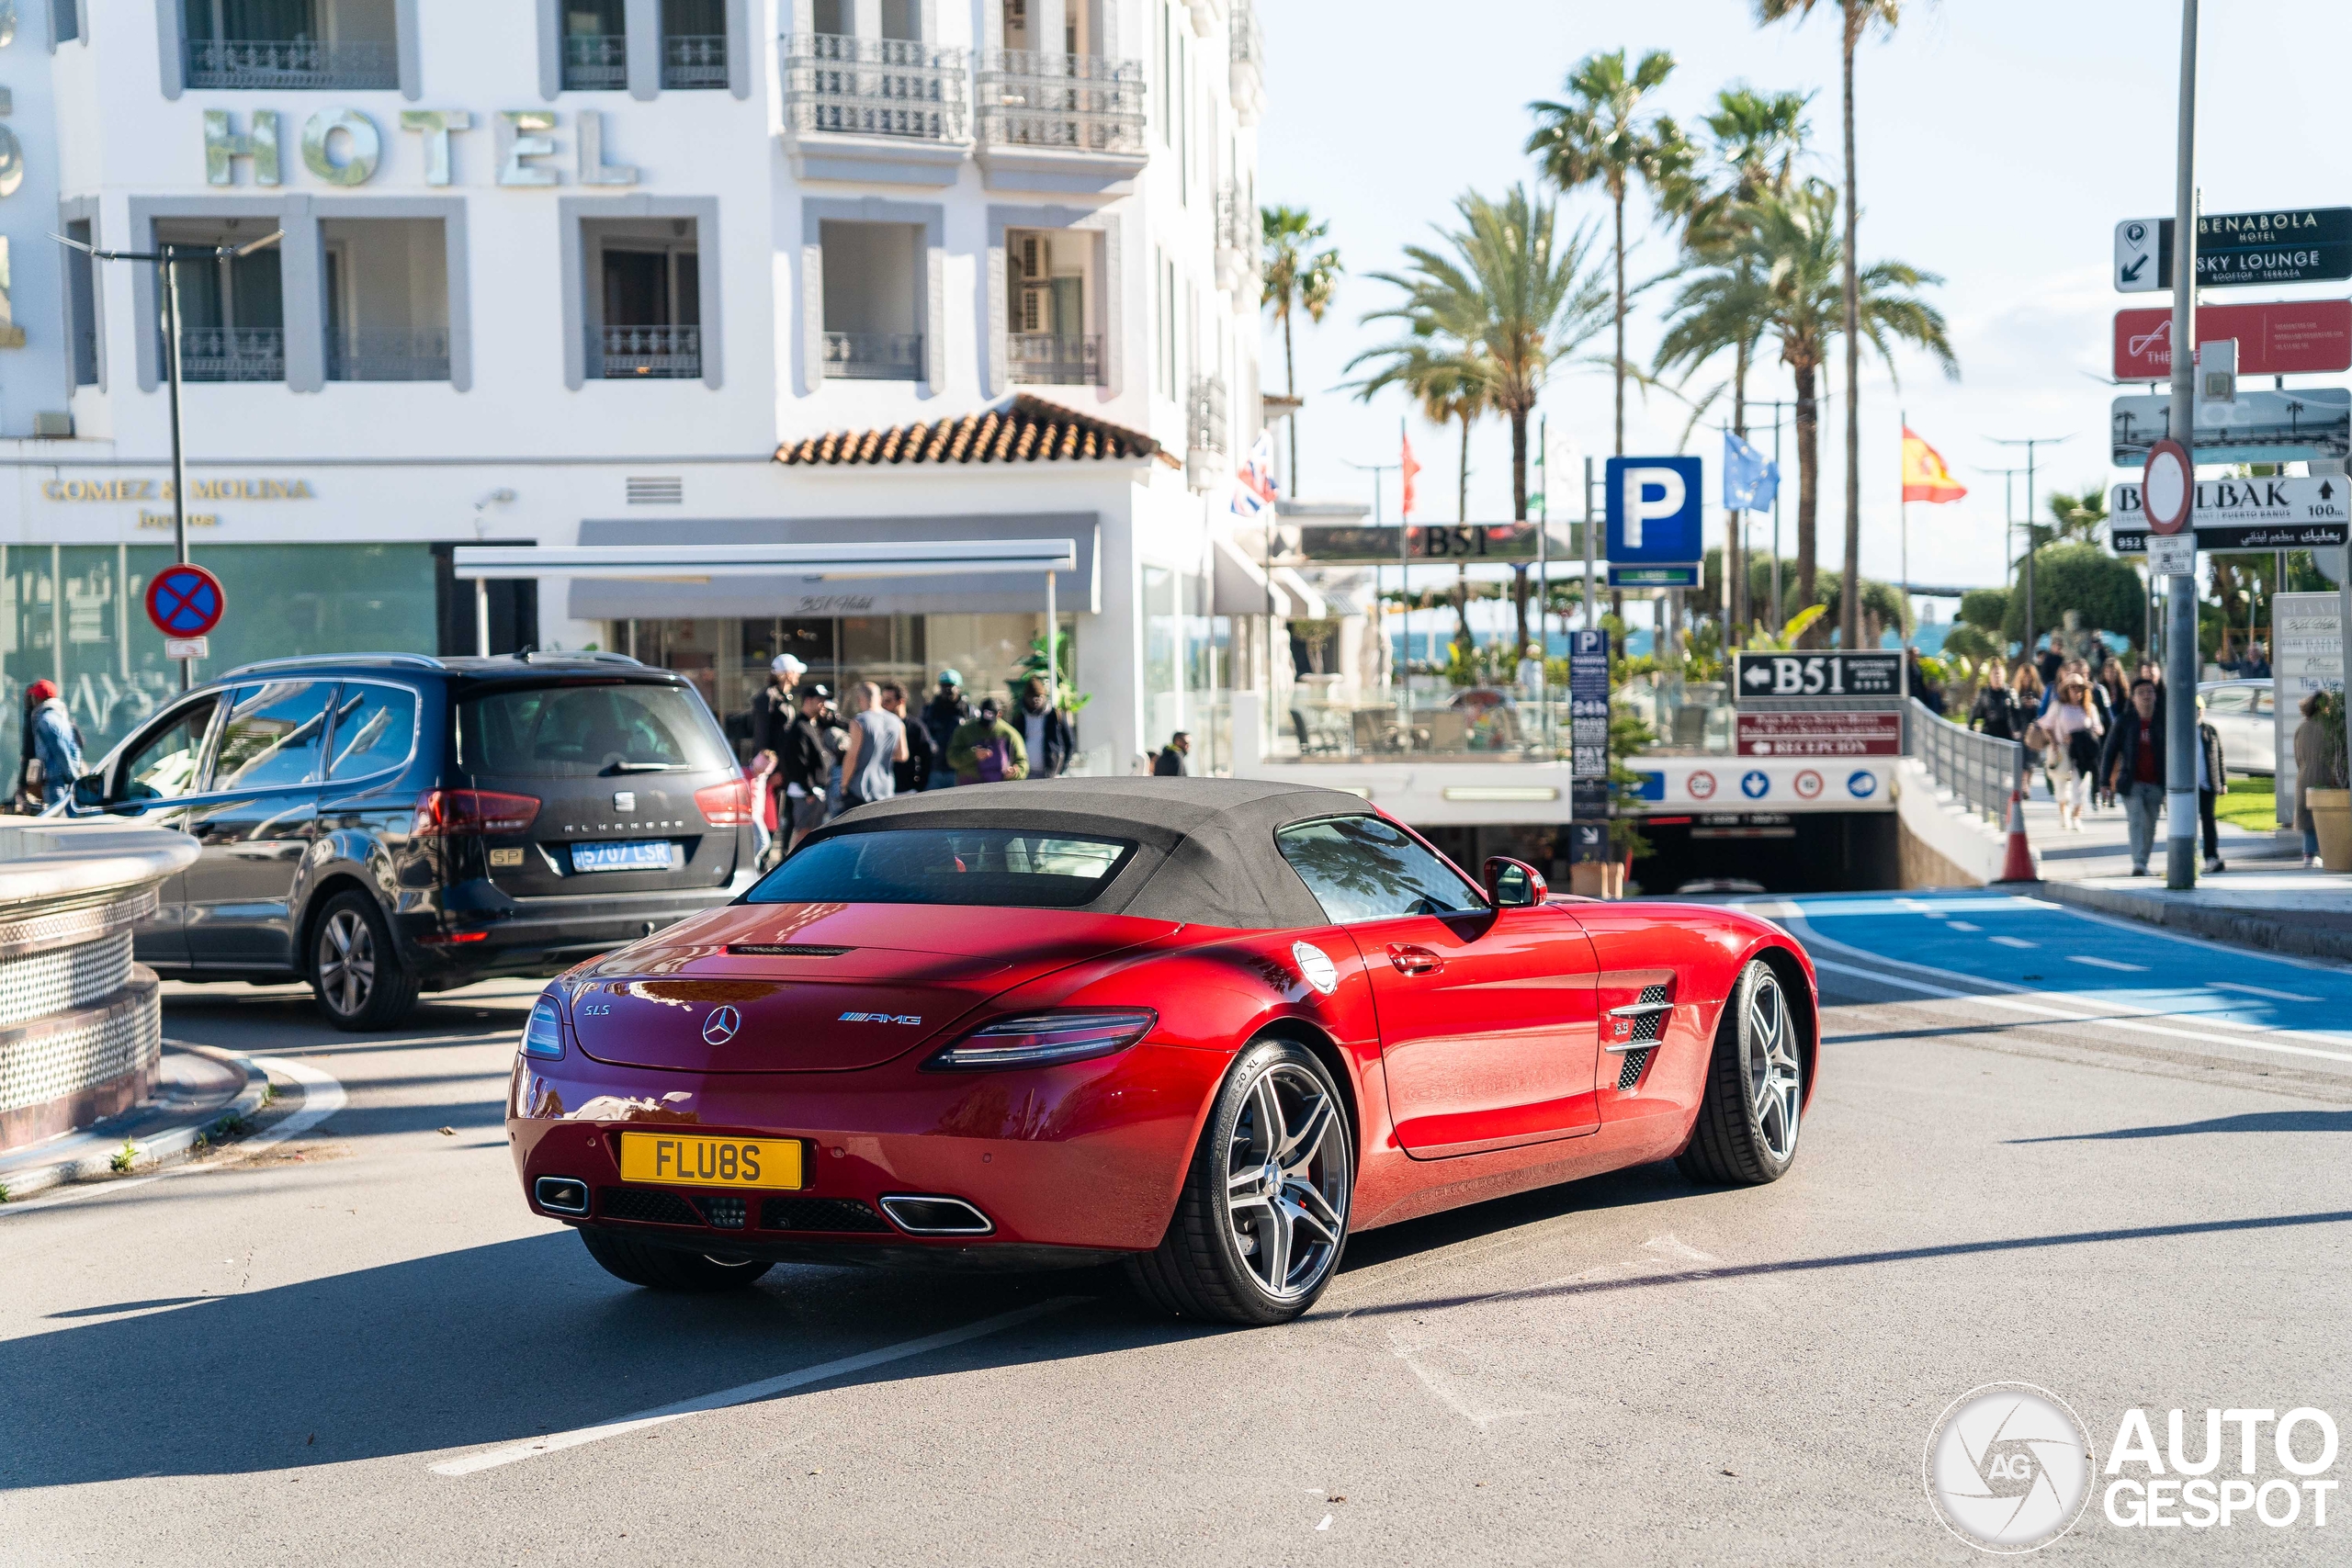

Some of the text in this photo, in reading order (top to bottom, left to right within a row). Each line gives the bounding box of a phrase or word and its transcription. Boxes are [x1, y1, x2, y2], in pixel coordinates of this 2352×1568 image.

[203, 107, 639, 186] HOTEL
[2199, 212, 2318, 233] BENABOLA
[2239, 231, 2276, 243] HOTEL
[2197, 250, 2320, 273] SKY LOUNGE
[2263, 268, 2301, 280] TERRAZA
[41, 479, 154, 502] GOMEZ
[190, 478, 312, 501] MOLINA
[1623, 467, 1686, 548] P
[2222, 510, 2257, 519] PUERTO
[1427, 526, 1487, 555] B51
[2117, 536, 2142, 549] 952
[1581, 631, 1598, 653] P
[1770, 657, 1846, 694] B51
[1572, 700, 1608, 716] 24h
[492, 851, 519, 865] SP
[583, 843, 627, 863] 5707
[633, 842, 669, 862] LSR
[584, 1004, 611, 1016] SLS
[864, 1012, 922, 1025] AMG
[1246, 1058, 1260, 1072] XL
[656, 1140, 762, 1181] FLU8S
